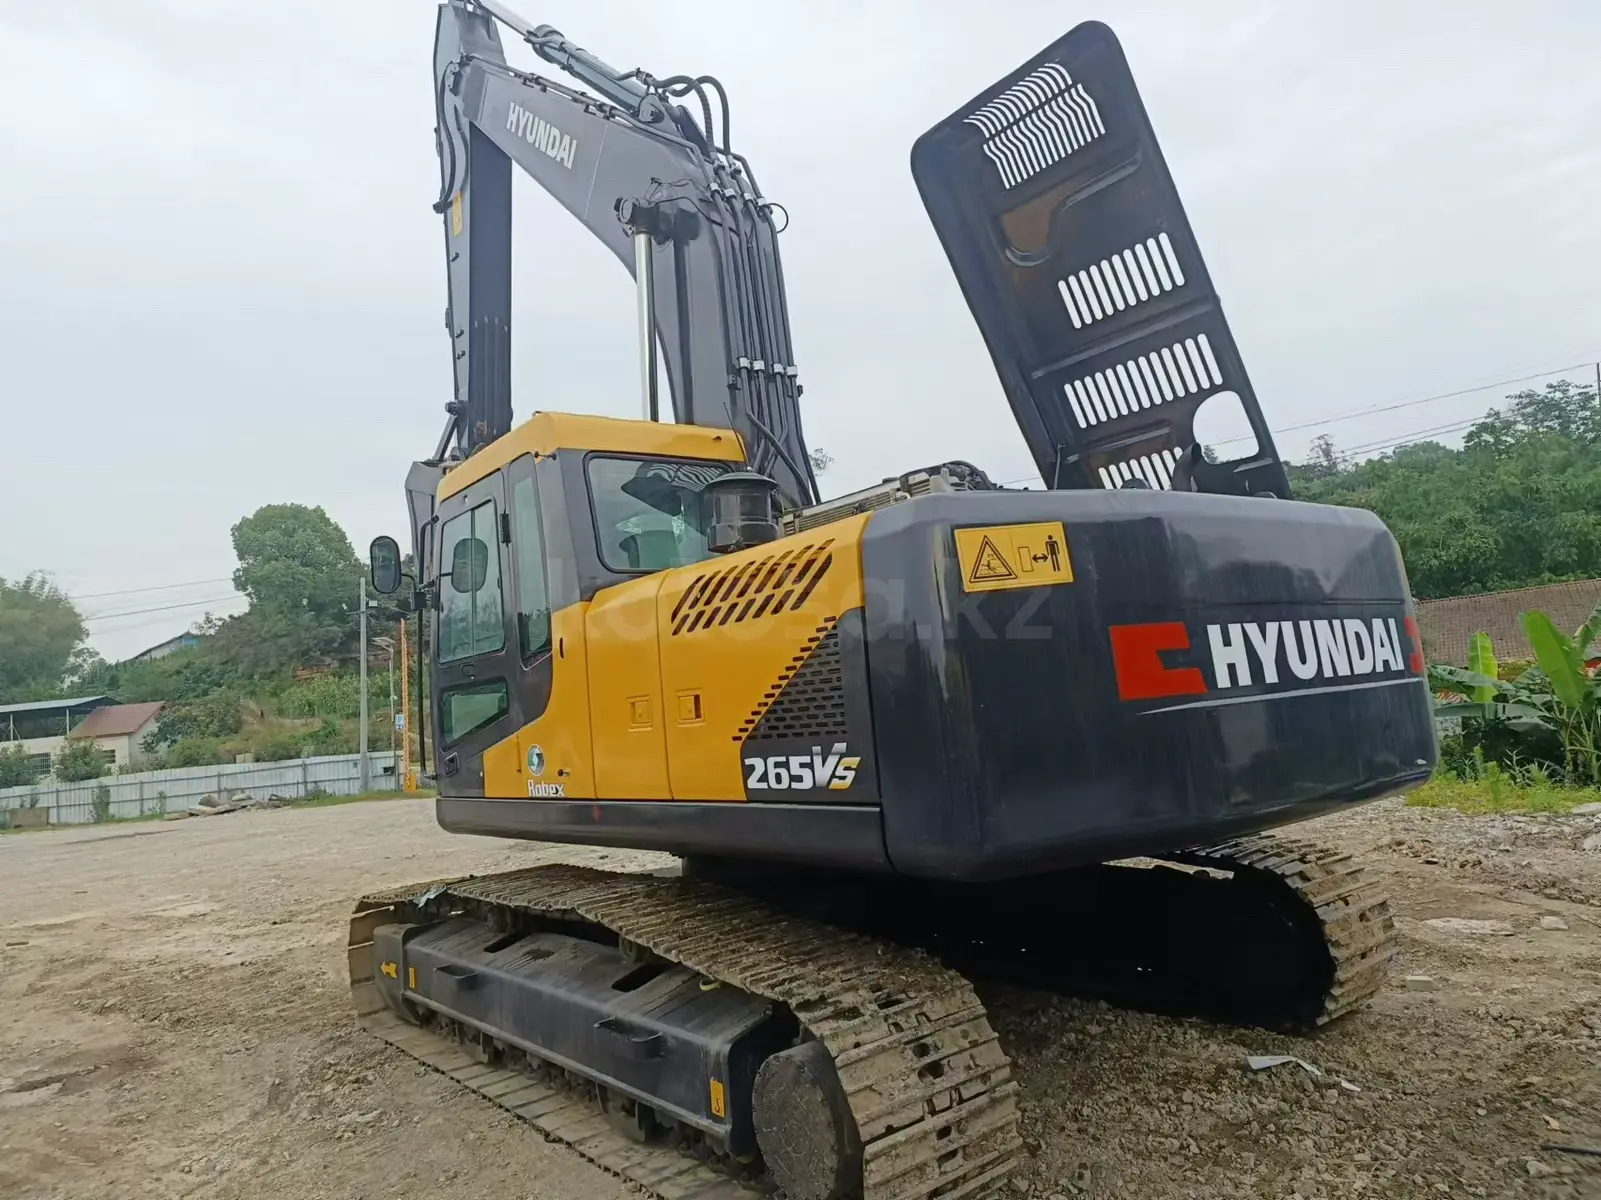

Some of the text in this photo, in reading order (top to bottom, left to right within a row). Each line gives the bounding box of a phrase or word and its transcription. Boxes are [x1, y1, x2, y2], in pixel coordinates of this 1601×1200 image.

[506, 101, 578, 170] HYUNDAI
[1206, 617, 1405, 689] HYUNDAI
[527, 779, 565, 797] Robex
